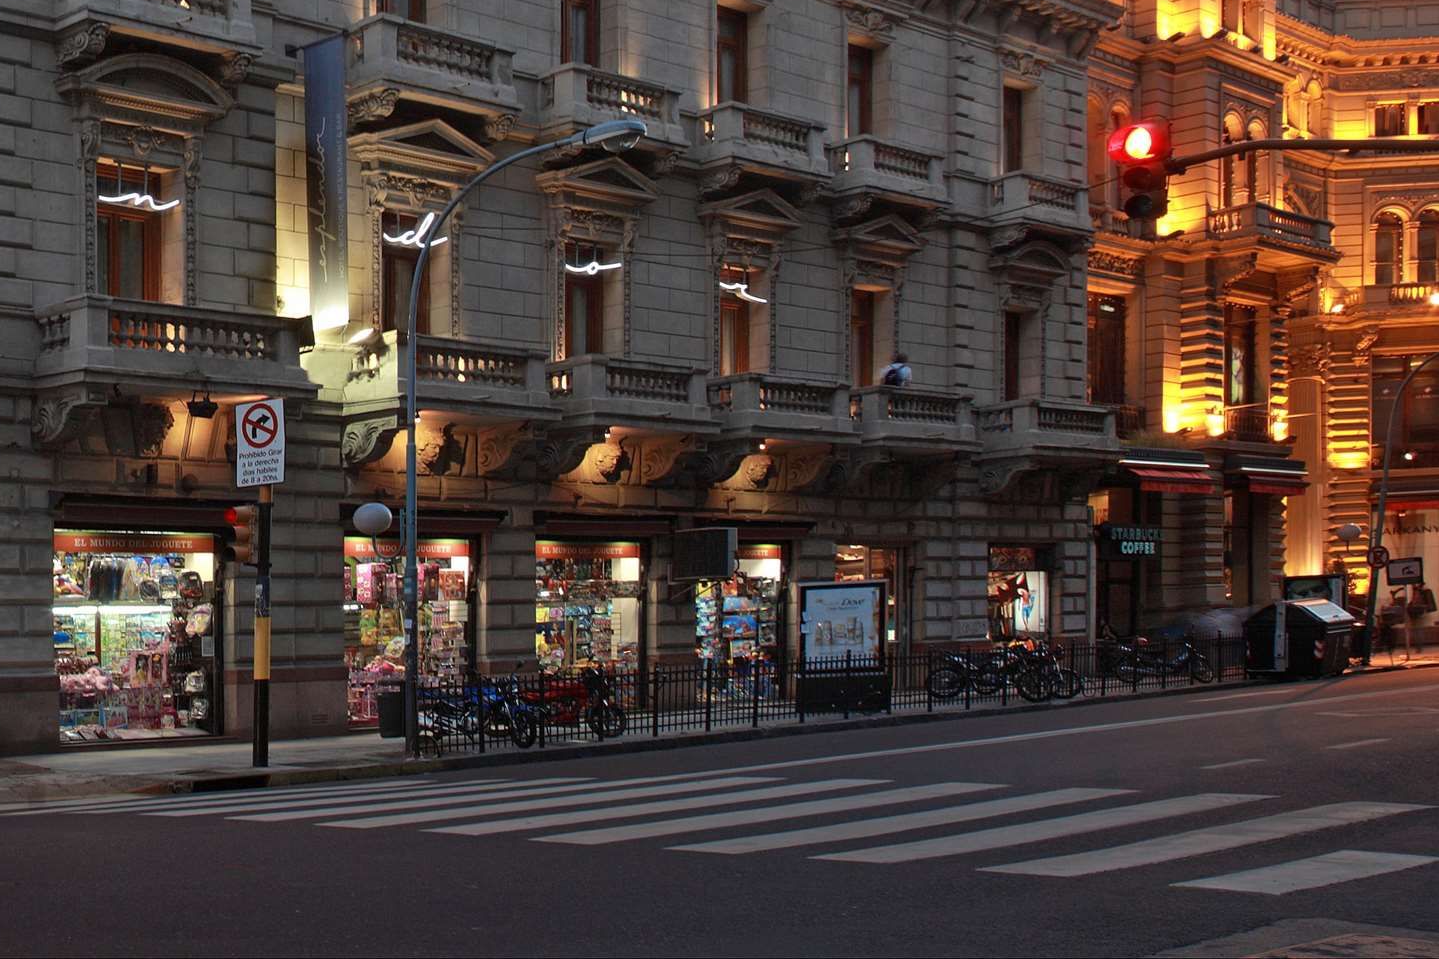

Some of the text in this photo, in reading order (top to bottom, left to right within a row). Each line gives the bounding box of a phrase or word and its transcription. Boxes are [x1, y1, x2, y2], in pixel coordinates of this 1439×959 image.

[73, 538, 193, 549] EL MUNDO DEL JUGUETE
[1121, 541, 1156, 554] COFFEE
